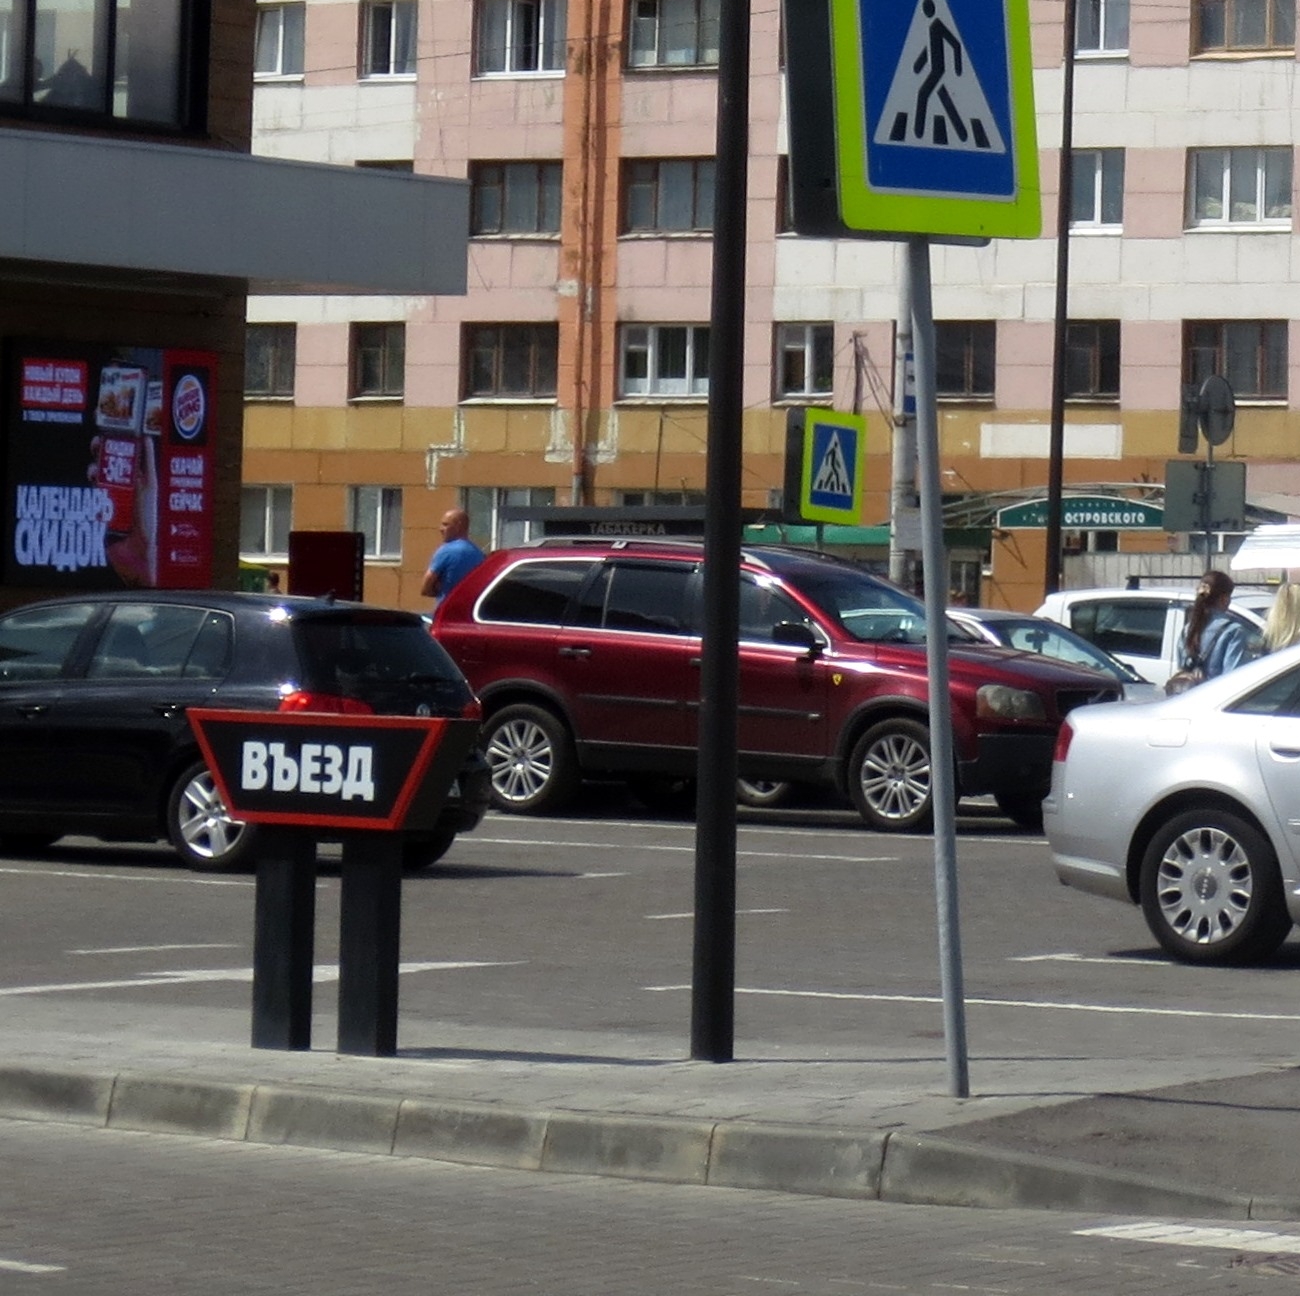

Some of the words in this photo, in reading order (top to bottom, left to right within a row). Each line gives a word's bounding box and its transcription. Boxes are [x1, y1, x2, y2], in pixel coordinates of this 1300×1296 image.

[16, 484, 114, 522] КАЛЕНДАРЬ
[1064, 512, 1146, 524] ОСТРОВСКОГО
[15, 520, 108, 571] СКИДОК
[241, 741, 375, 802] ВЪЕЗД
